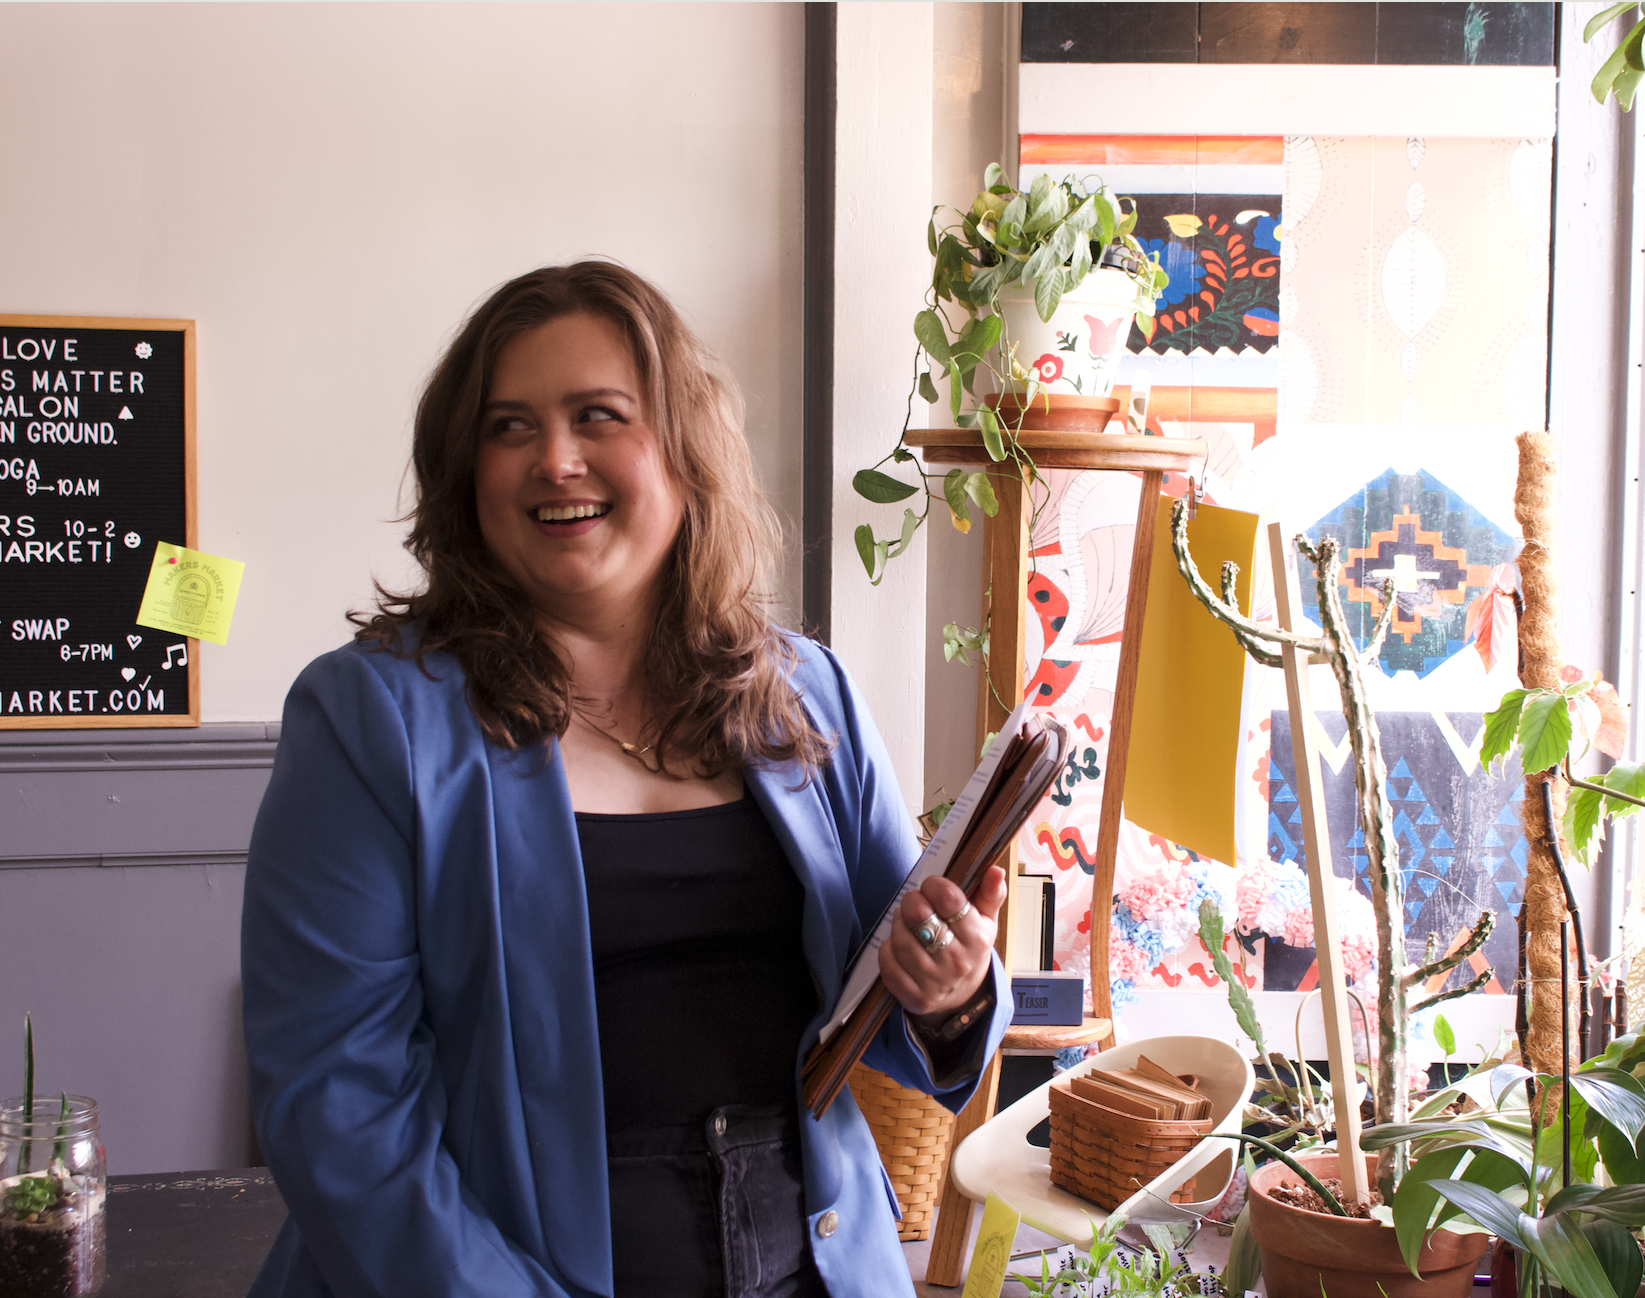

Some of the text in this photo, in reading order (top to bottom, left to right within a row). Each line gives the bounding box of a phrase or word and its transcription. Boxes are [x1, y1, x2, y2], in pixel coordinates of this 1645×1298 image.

[2, 336, 78, 361] LOVE
[1, 369, 145, 394] S MATTER
[0, 395, 79, 419] AL ON
[26, 421, 118, 445] GROUND.
[0, 540, 112, 563] ARKET!
[163, 561, 225, 603] MAKERS MARKET
[11, 617, 70, 641] SWAP
[60, 643, 113, 662] 6-7PM
[0, 688, 165, 713] ARKET.COM
